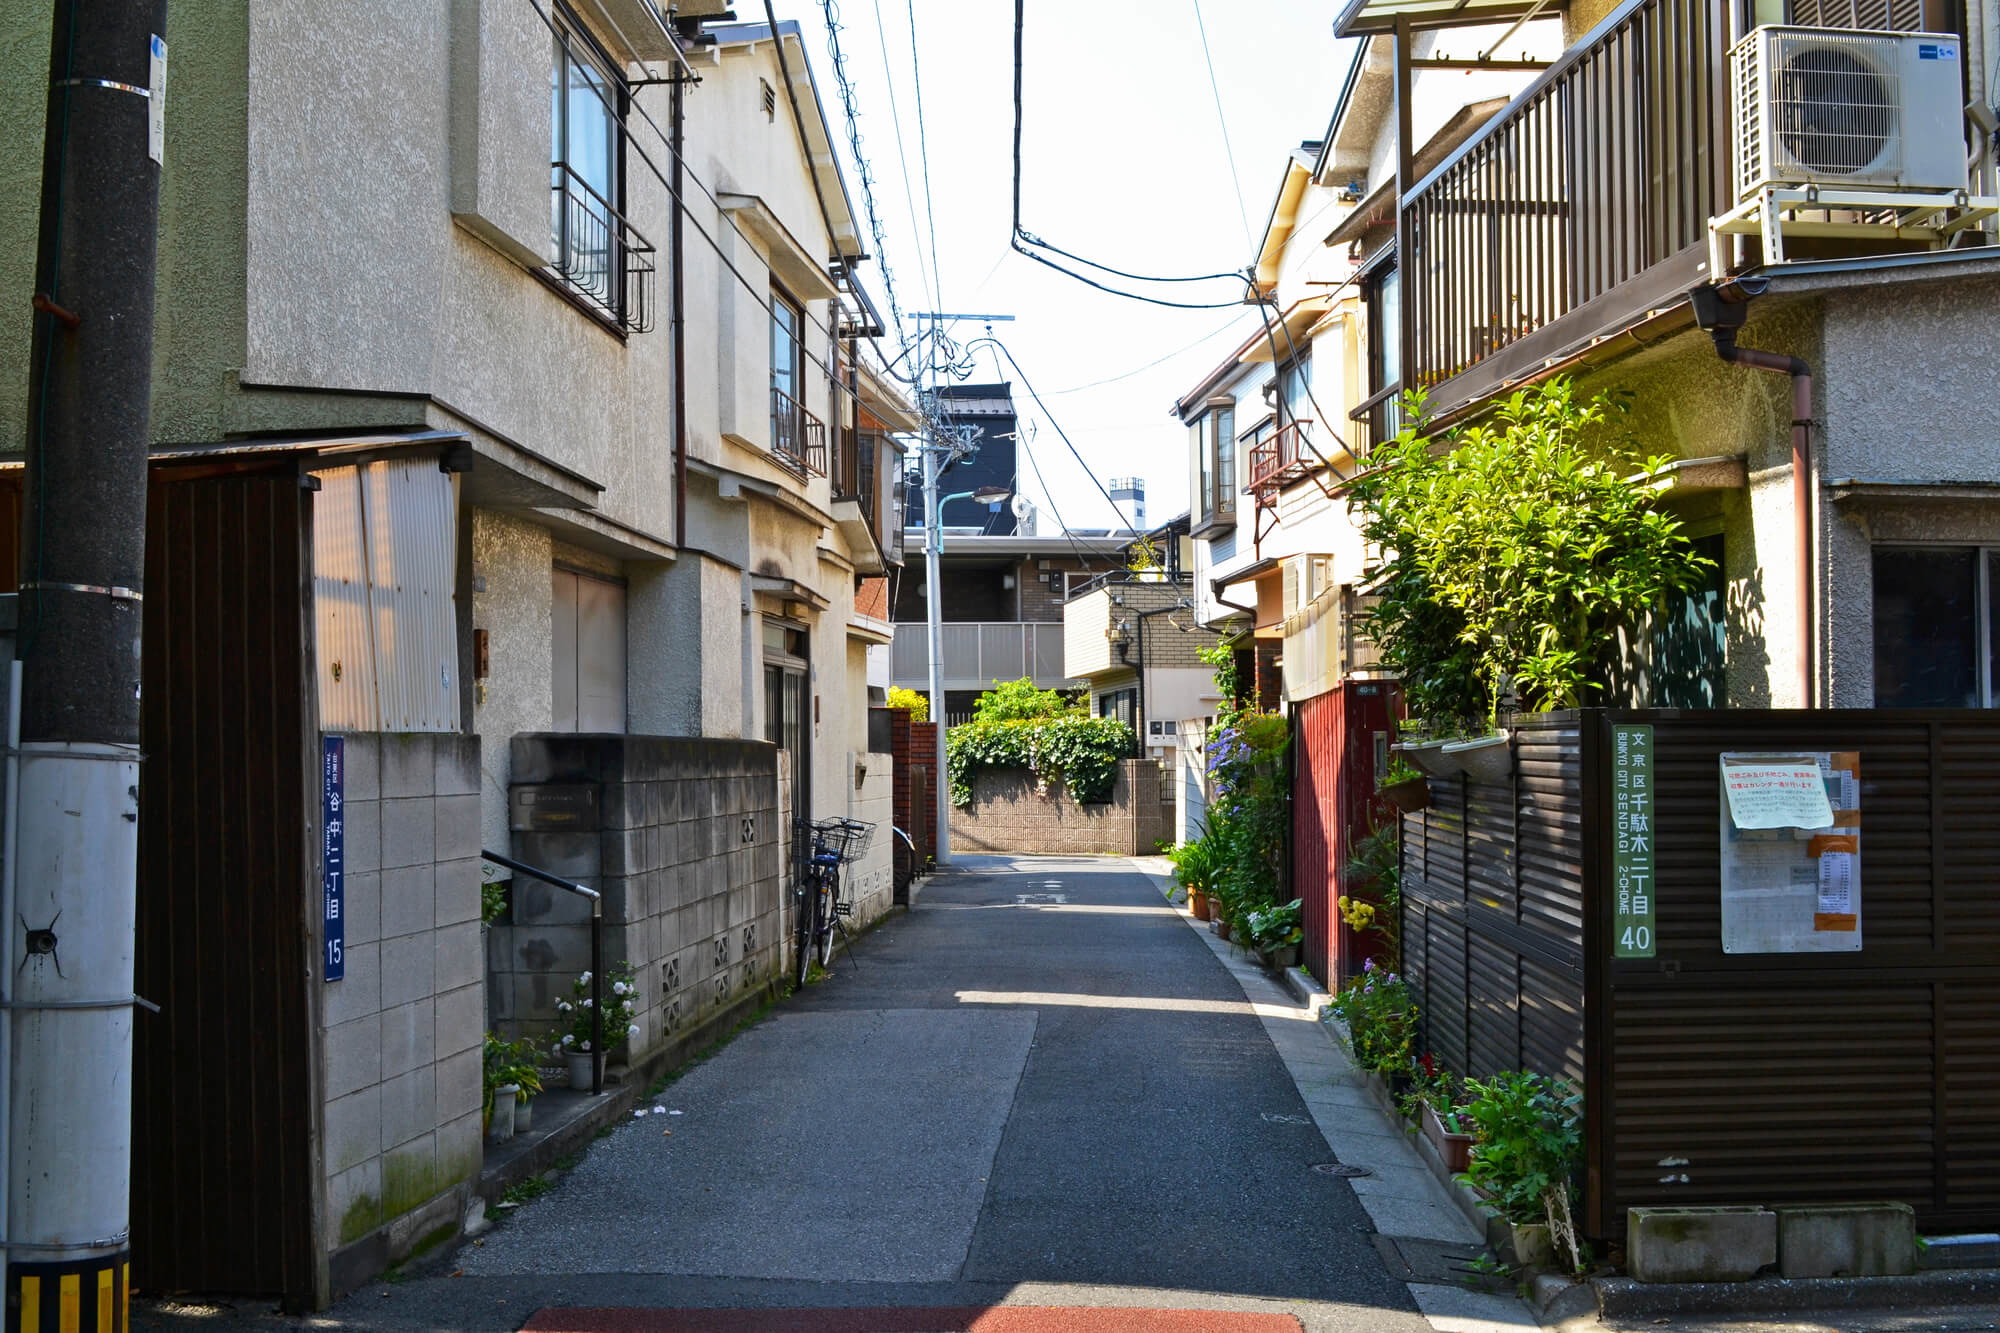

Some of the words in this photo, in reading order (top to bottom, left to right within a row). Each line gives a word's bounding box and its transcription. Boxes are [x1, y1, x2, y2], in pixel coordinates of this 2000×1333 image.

[1617, 732, 1628, 766] BUNKYO
[1617, 770, 1629, 789] CITY
[1618, 792, 1629, 853] SENDAGI
[1618, 865, 1630, 914] 2-CHOME
[328, 938, 342, 966] 15
[1620, 926, 1650, 951] 40
